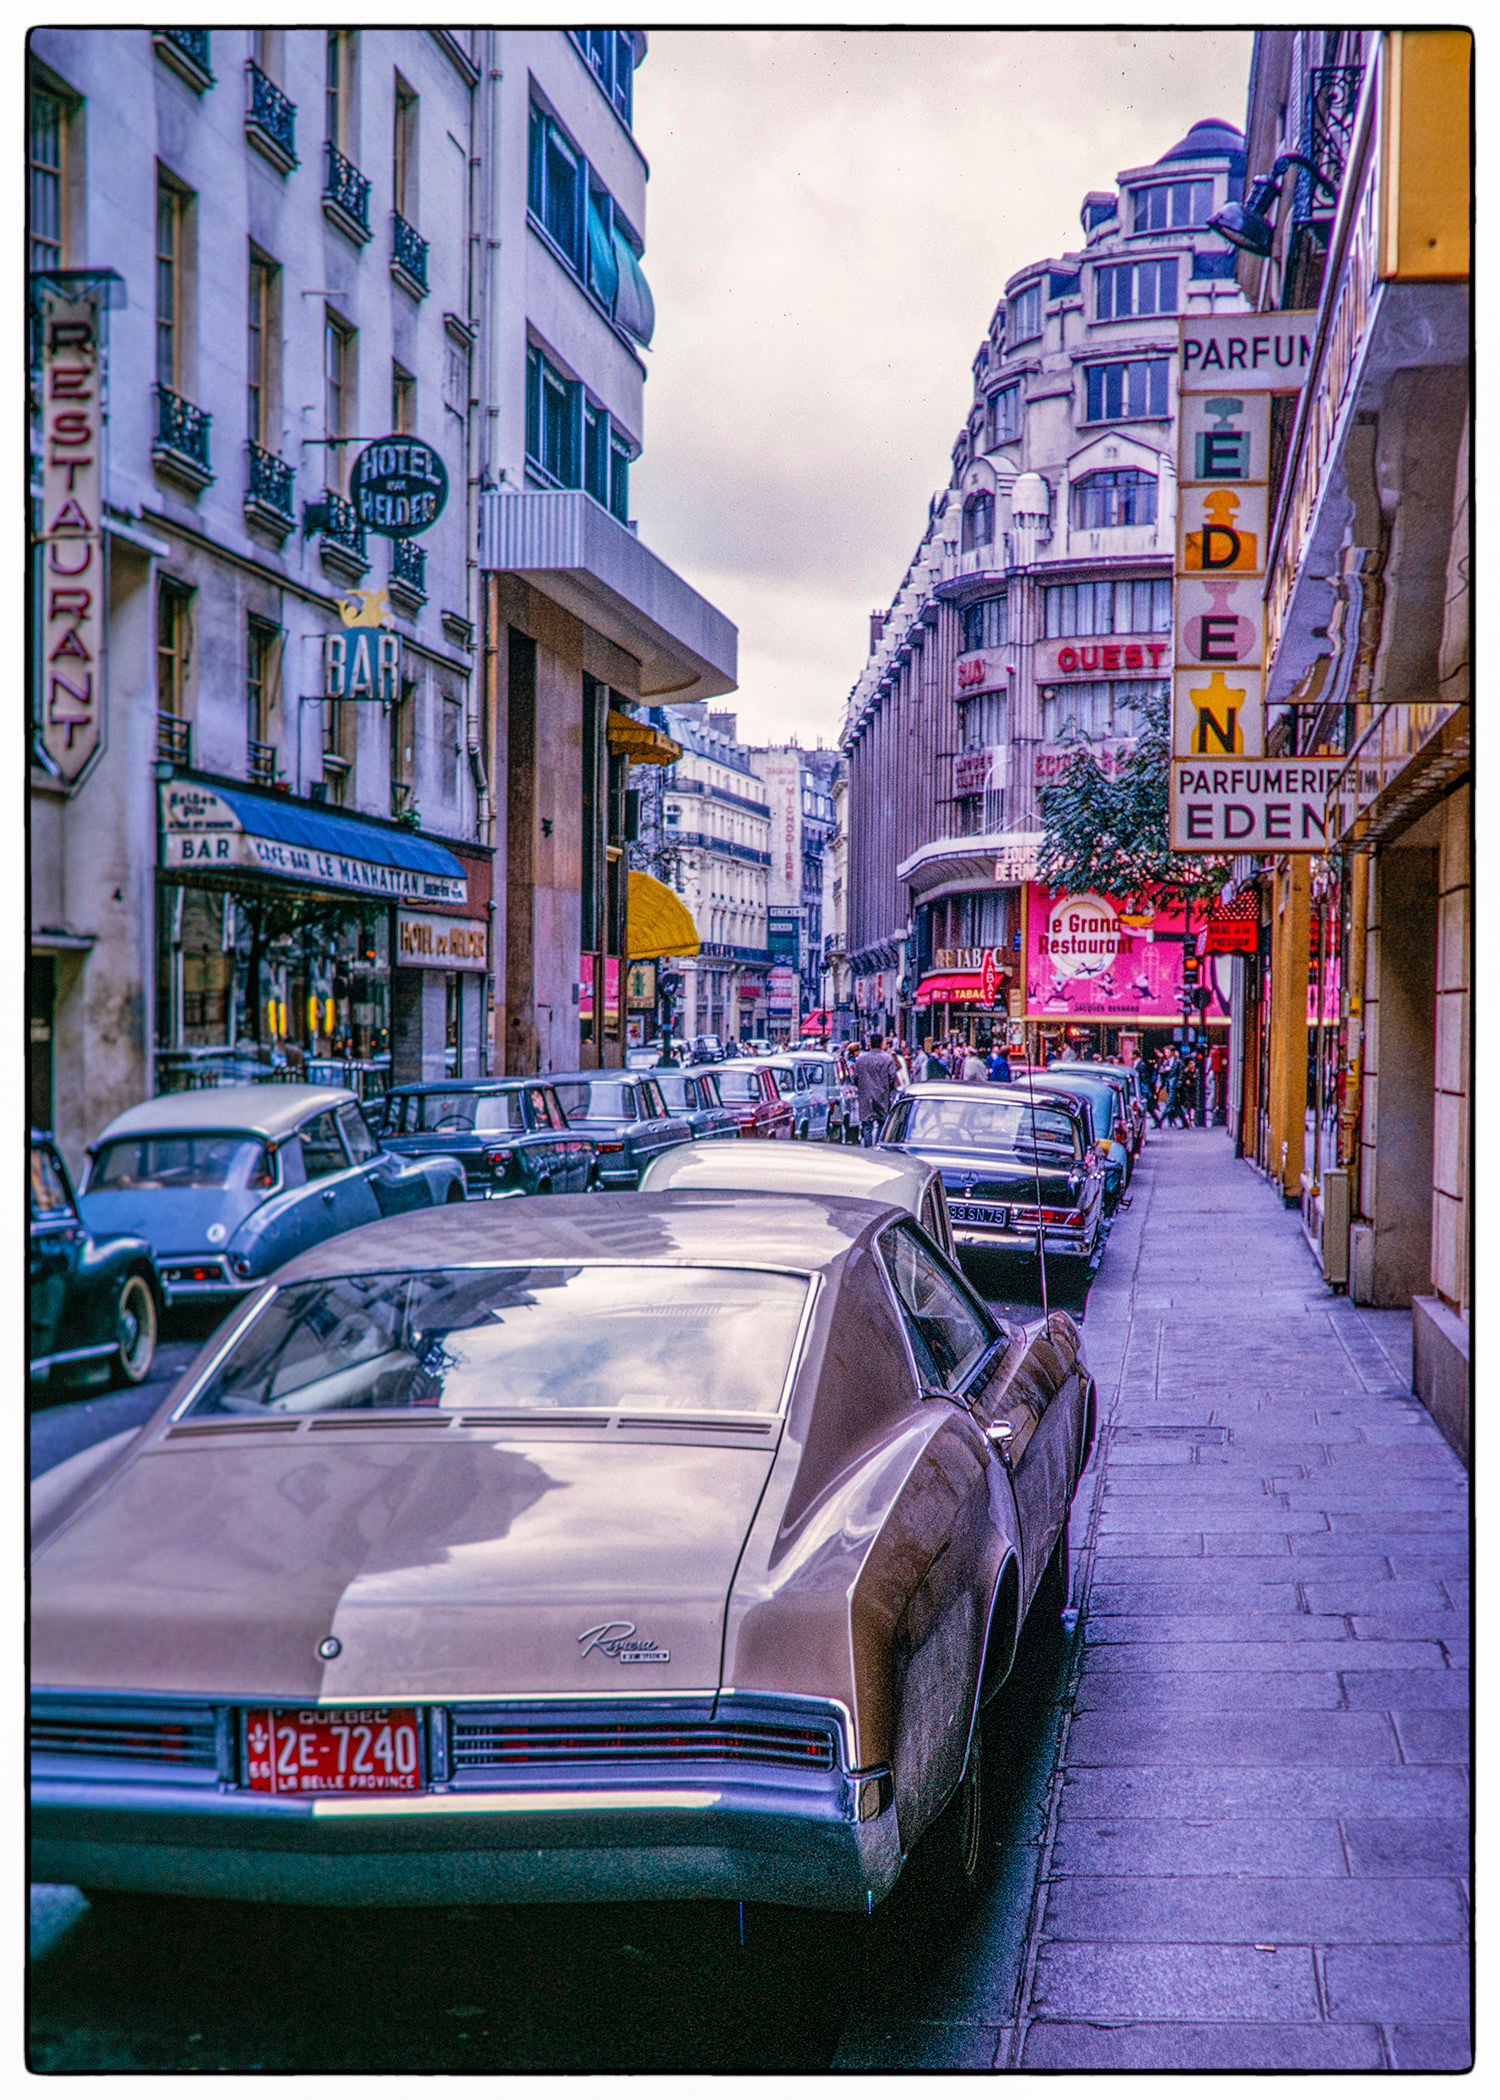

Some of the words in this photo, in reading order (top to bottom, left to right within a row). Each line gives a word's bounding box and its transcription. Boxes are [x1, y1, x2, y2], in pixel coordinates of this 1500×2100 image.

[360, 445, 441, 485] HOTEL
[360, 487, 436, 525] HELDER
[48, 321, 93, 748] RESTAURANT
[1198, 431, 1242, 753] EDEN
[326, 634, 398, 699] BAR
[958, 659, 985, 687] SUD
[1058, 644, 1167, 672] OUEST
[1179, 769, 1340, 794] PARFUMERIE
[1187, 803, 1335, 839] EDEN
[181, 839, 230, 859] BAR
[317, 855, 334, 878] LE
[339, 858, 419, 896] MANHATTAN
[400, 921, 434, 954] HOTEL
[1045, 914, 1062, 934] le
[1069, 914, 1121, 934] Grand
[1039, 935, 1133, 954] Restaurant
[986, 956, 995, 999] TABAC
[578, 1621, 659, 1658] Riviera
[276, 1725, 417, 1774] 2E-7240
[249, 1760, 271, 1779] 66
[278, 1776, 299, 1790] LA
[301, 1775, 345, 1790] BELLE
[349, 1774, 415, 1789] PROVINCE
